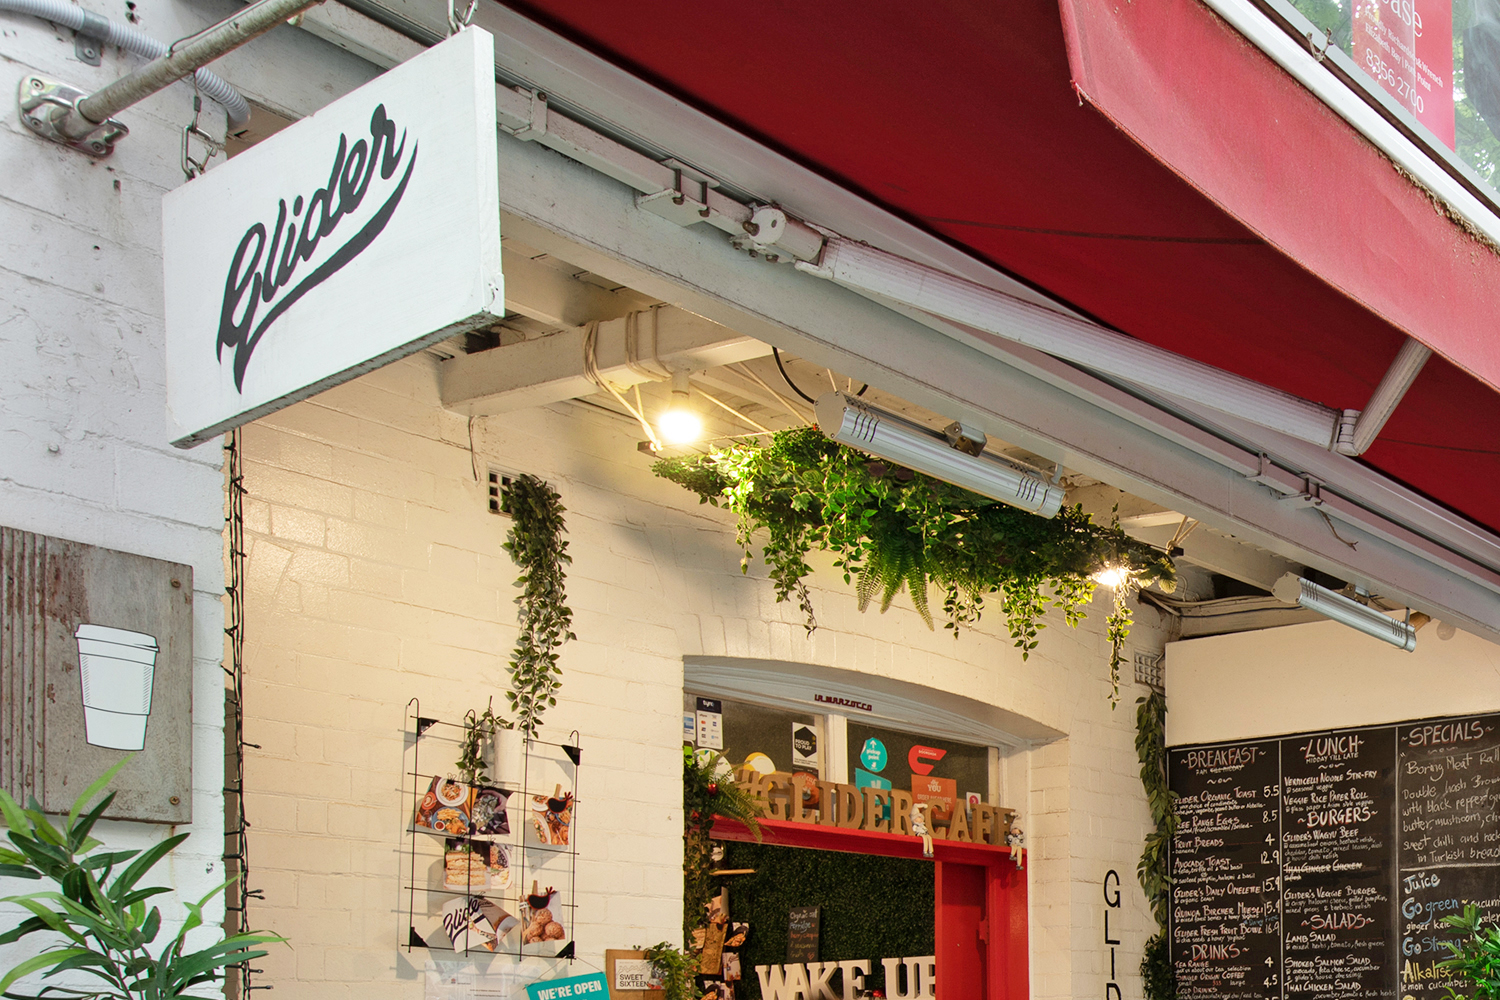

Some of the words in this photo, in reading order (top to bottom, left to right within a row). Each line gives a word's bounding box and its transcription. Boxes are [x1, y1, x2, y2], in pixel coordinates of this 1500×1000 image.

[1391, 47, 1400, 64] Bay
[1417, 72, 1431, 92] Point
[1366, 48, 1395, 87] 8356
[1397, 77, 1424, 113] 2700
[217, 103, 418, 395] Glider
[1408, 721, 1484, 747] SPECIALS
[1305, 735, 1358, 759] LUNCH
[1188, 747, 1258, 770] BREAKFAST
[1320, 773, 1343, 782] NOODLE
[1201, 790, 1232, 802] ORGANIC
[1234, 786, 1256, 798] TOAST
[1263, 785, 1280, 798] 5.5
[1310, 792, 1327, 803] RICE
[1329, 790, 1349, 801] PAPER
[1350, 788, 1368, 800] ROLL
[1402, 785, 1436, 800] Double
[1427, 799, 1452, 813] black
[1192, 816, 1213, 827] RANGE
[1262, 810, 1278, 823] 8.5
[1307, 807, 1371, 828] BURGERS
[1340, 826, 1358, 838] BEEF
[1433, 834, 1454, 848] chilli
[1460, 832, 1479, 843] and
[1194, 836, 1224, 848] BREADS
[1265, 833, 1275, 846] 4
[1205, 855, 1231, 866] TOAST
[1260, 850, 1280, 865] 12.9
[1418, 854, 1426, 862] in
[1430, 848, 1464, 862] Turkish
[1470, 845, 1500, 859] bread
[1205, 885, 1225, 897] DAILY
[1345, 885, 1377, 896] BURGER
[1403, 872, 1440, 894] Juice
[1402, 897, 1422, 919] Go
[1425, 898, 1459, 925] green
[1310, 913, 1365, 930] SALADS
[1403, 922, 1430, 935] ginger
[1286, 932, 1308, 943] LAMB
[1310, 931, 1336, 942] SALAD
[1192, 944, 1240, 961] DRINKS
[1403, 937, 1422, 956] Go
[1265, 957, 1273, 968] 4
[1315, 956, 1345, 967] SALMON
[1346, 954, 1370, 965] SALAD
[574, 980, 602, 994] OPEN
[1263, 974, 1278, 988] 4.5
[1284, 980, 1302, 992] THAI
[1303, 981, 1333, 991] CHICKEN
[1334, 979, 1361, 991] SALAD
[1401, 982, 1424, 992] lemon
